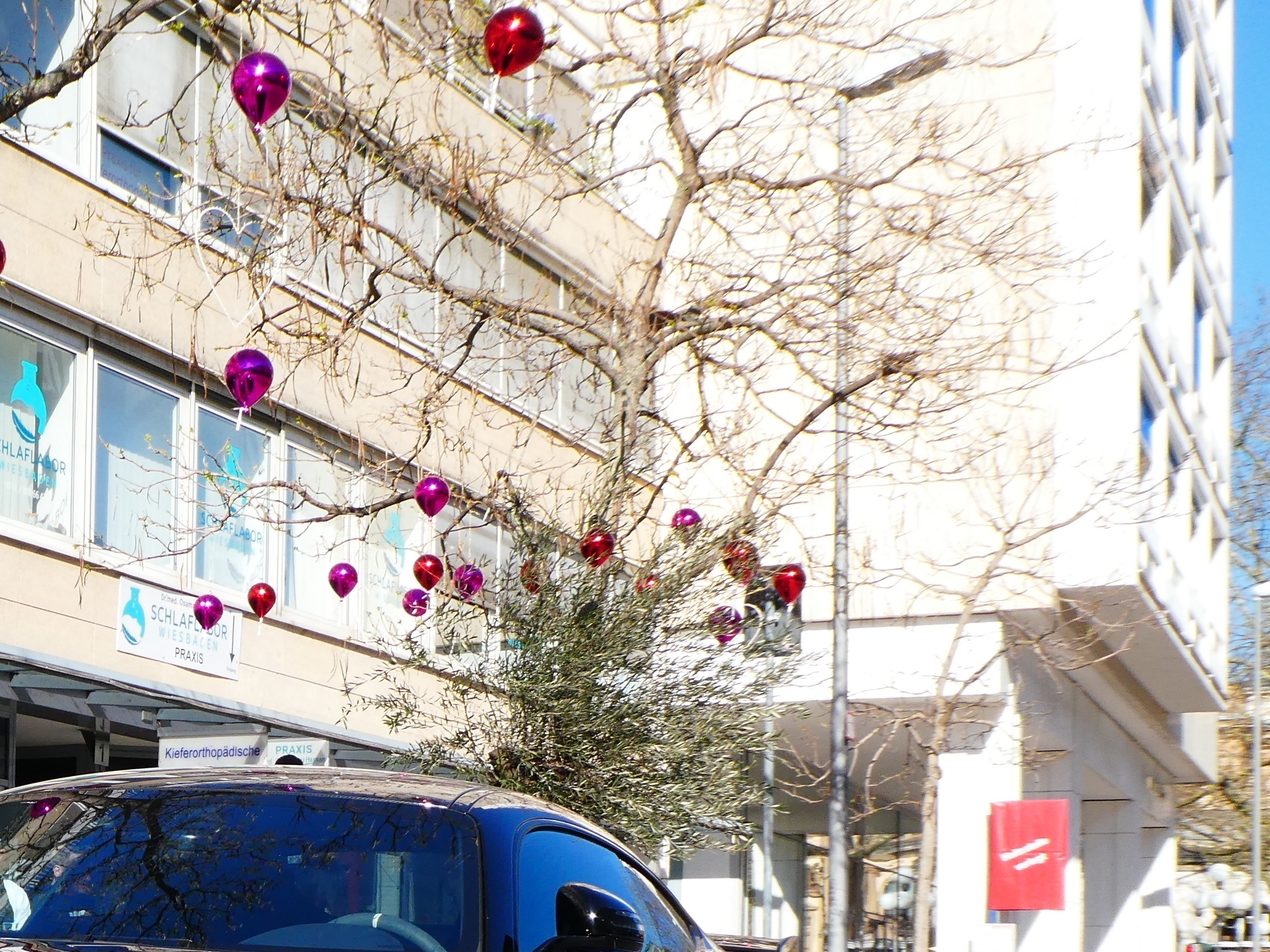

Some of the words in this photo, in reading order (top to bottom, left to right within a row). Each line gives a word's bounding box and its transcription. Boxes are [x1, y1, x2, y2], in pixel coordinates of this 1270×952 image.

[151, 604, 228, 640] SCHLAFLBOR
[175, 647, 204, 665] PRAXIS
[165, 746, 260, 760] Kieferorthopädische
[276, 744, 312, 755] PRAXIS
